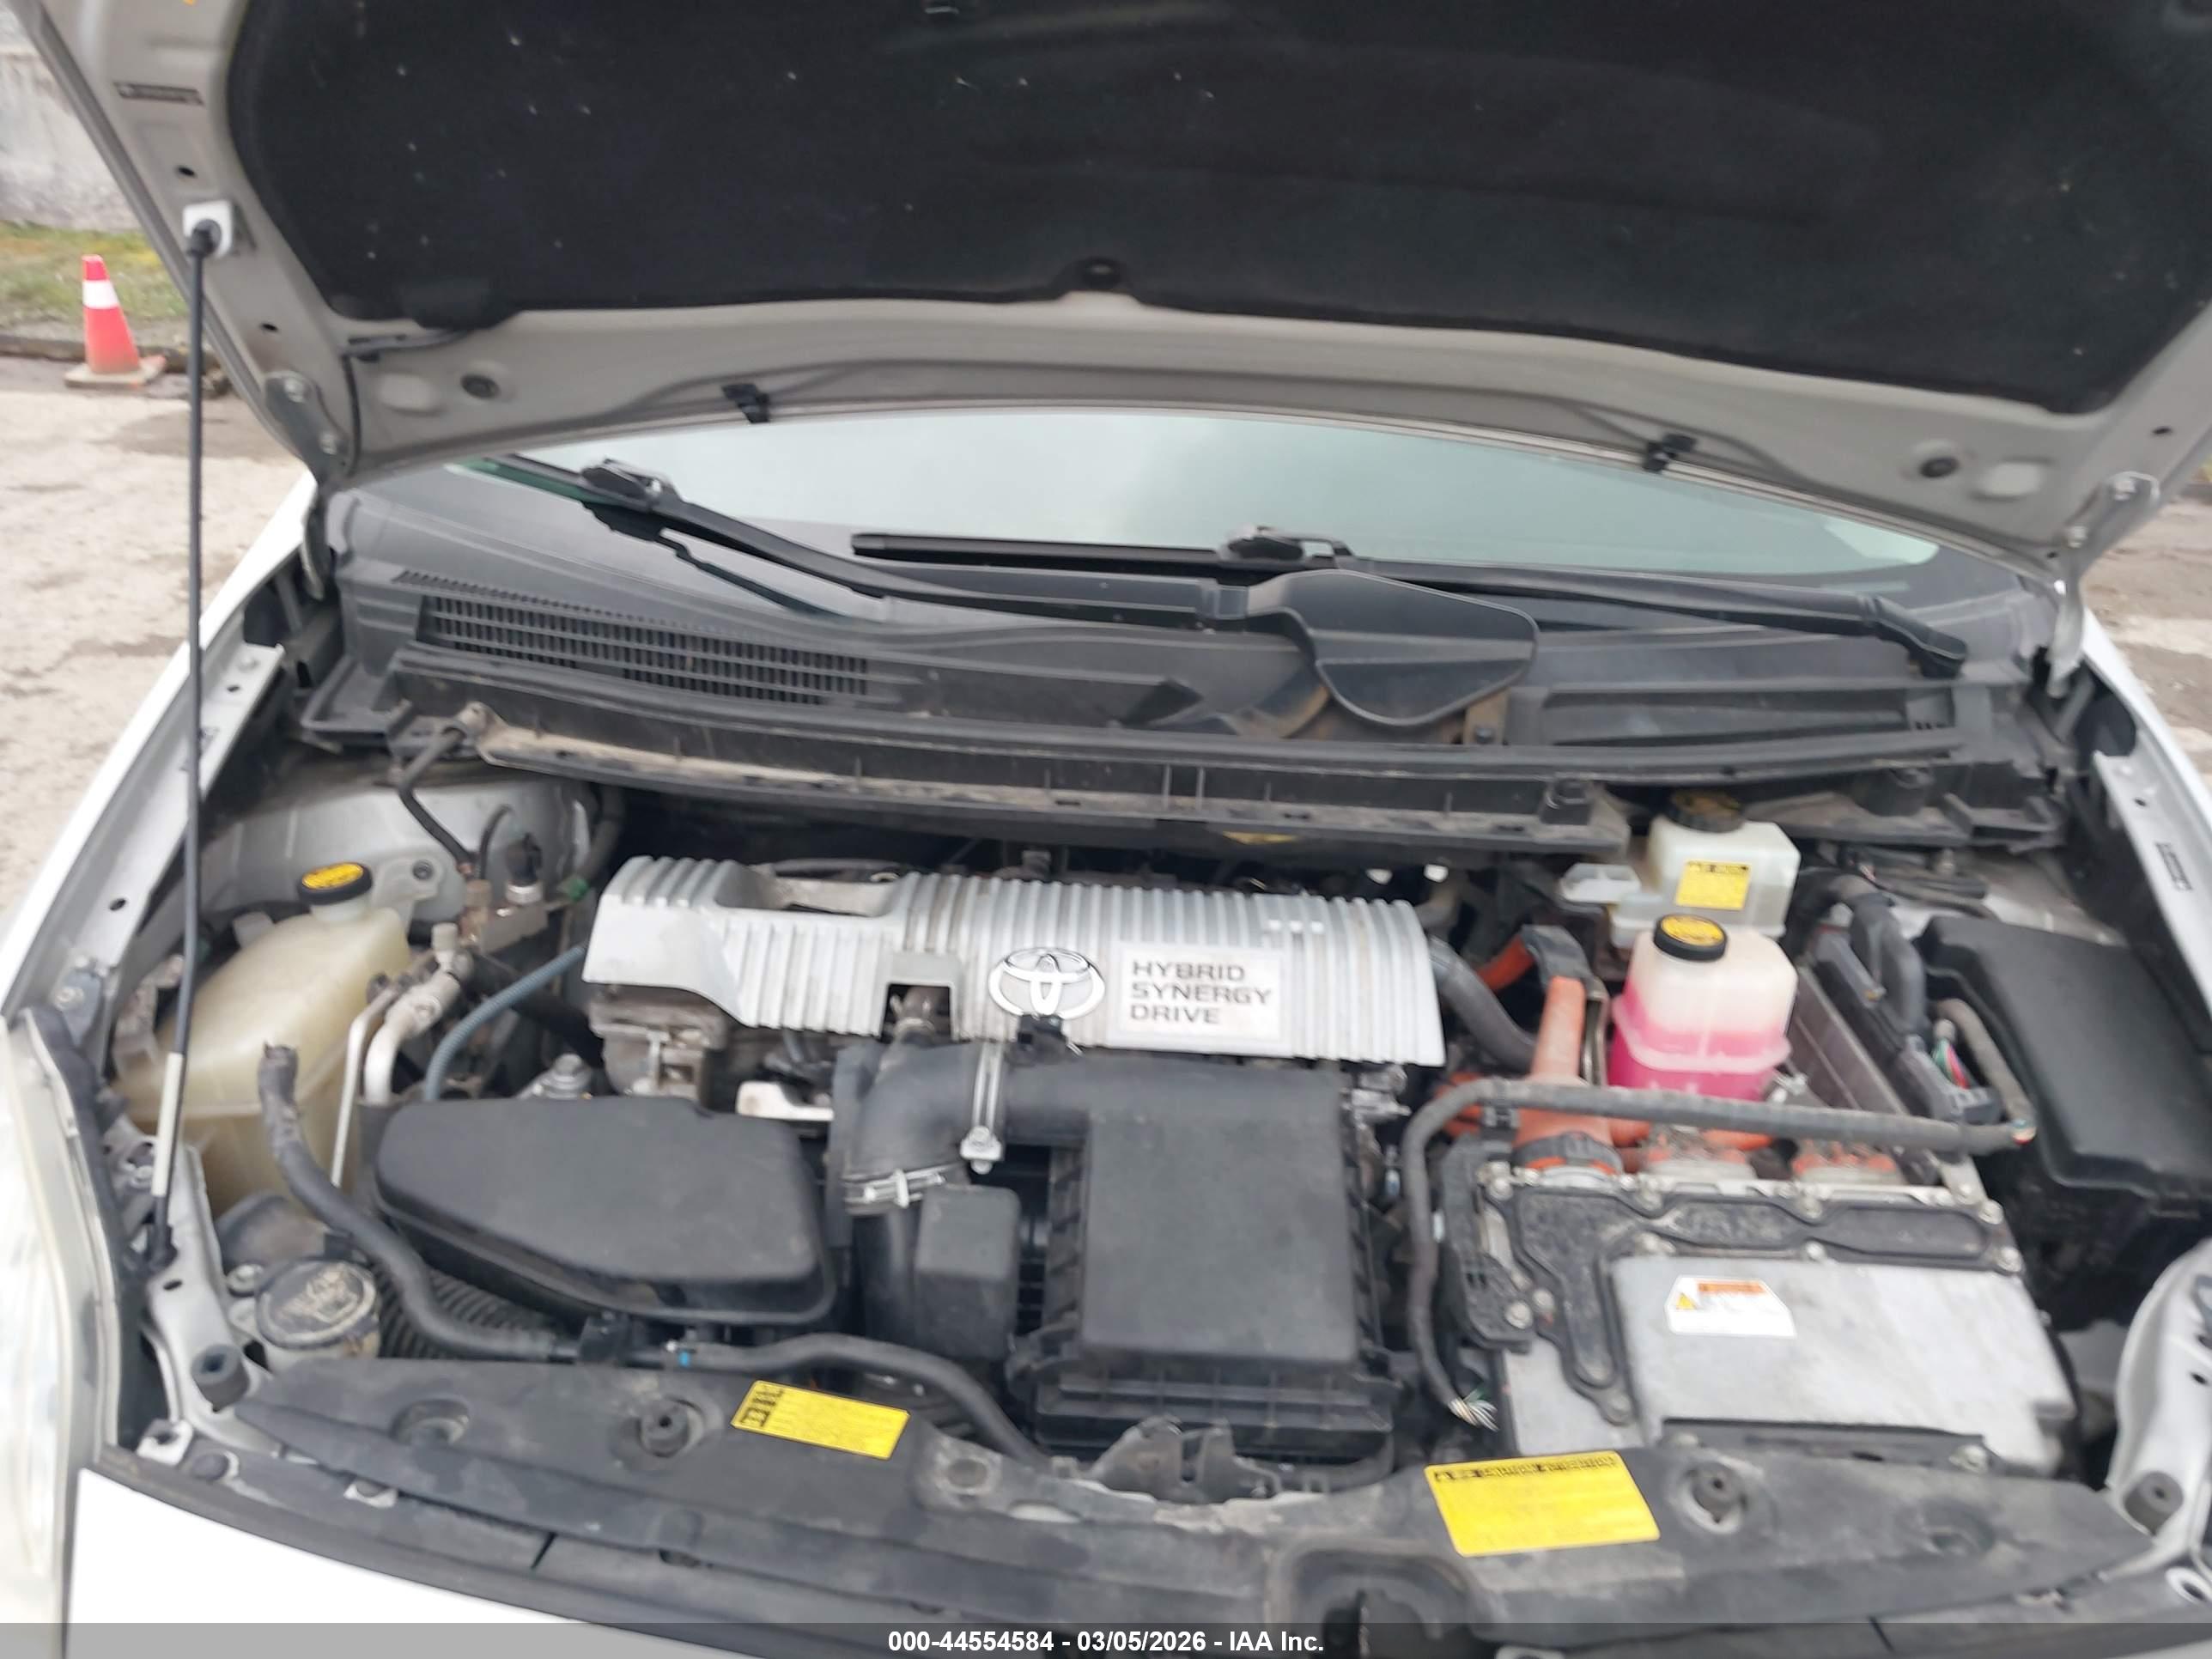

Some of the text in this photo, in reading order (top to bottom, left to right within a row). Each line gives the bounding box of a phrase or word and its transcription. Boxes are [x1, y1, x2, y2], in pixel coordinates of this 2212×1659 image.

[1133, 959, 1245, 981] HYBRID
[1131, 981, 1273, 1005] SYNERGY
[1129, 1003, 1220, 1024] DRIVE
